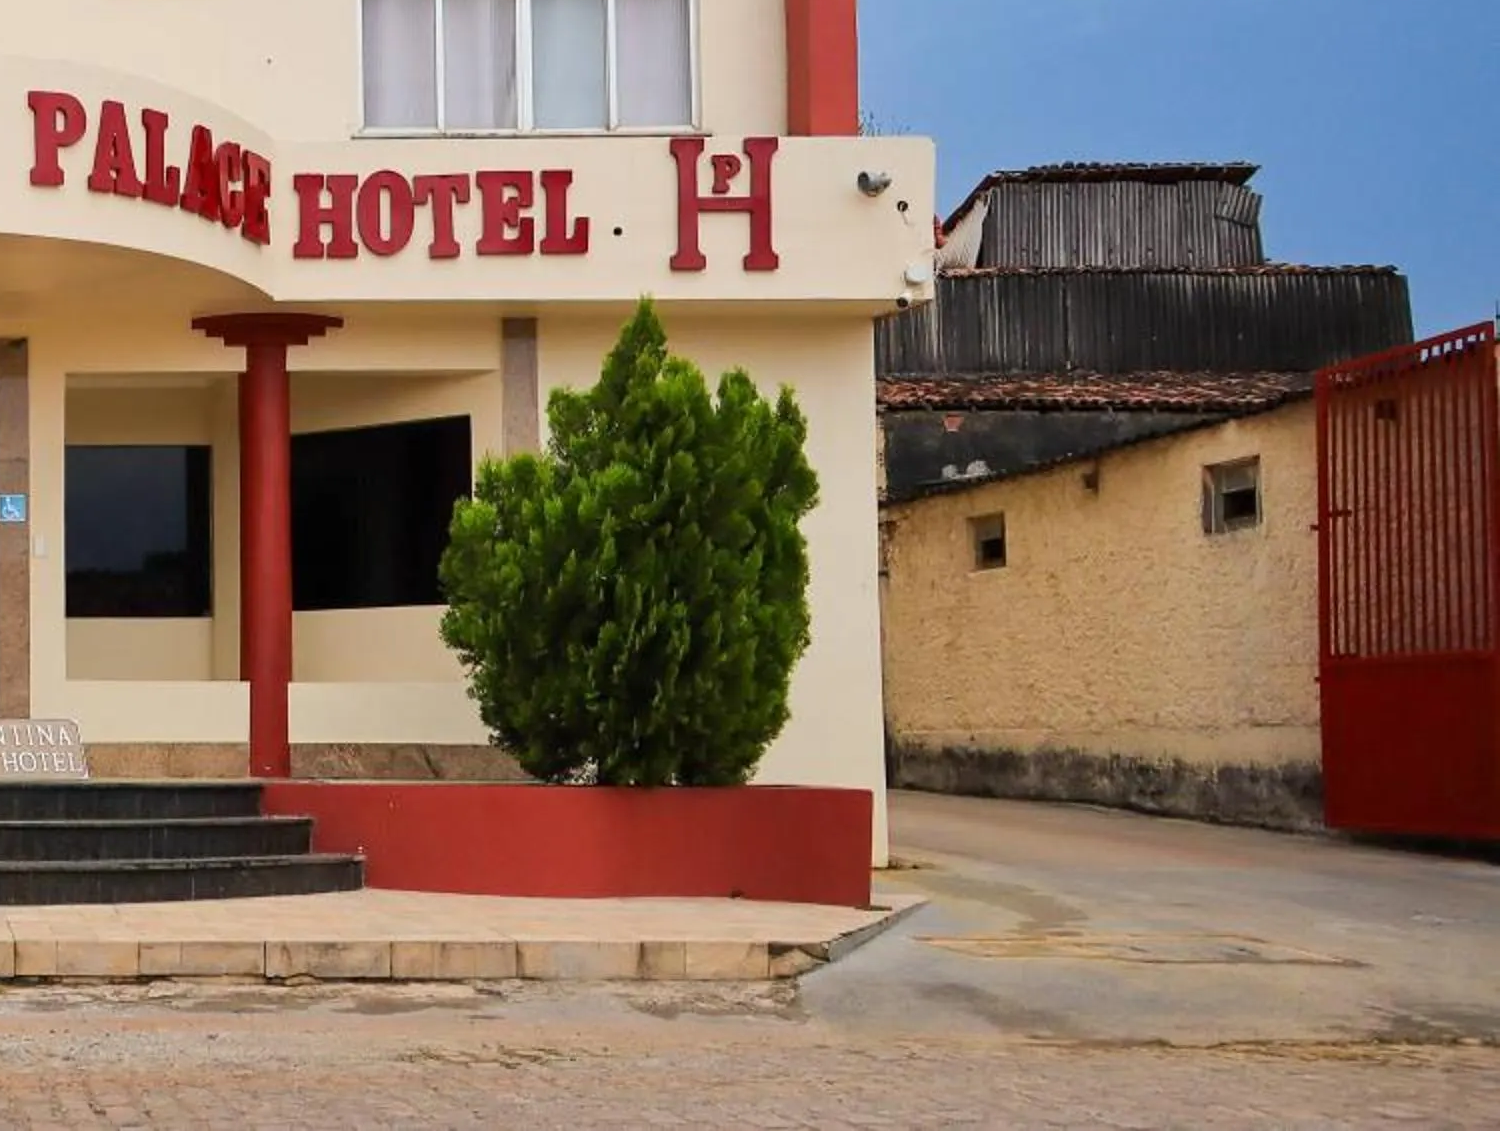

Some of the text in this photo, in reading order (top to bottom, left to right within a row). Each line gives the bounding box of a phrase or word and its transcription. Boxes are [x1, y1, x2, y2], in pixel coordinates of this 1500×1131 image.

[27, 90, 272, 246] PALACE
[293, 170, 590, 259] HOTEL
[1, 751, 86, 773] HOTEL
